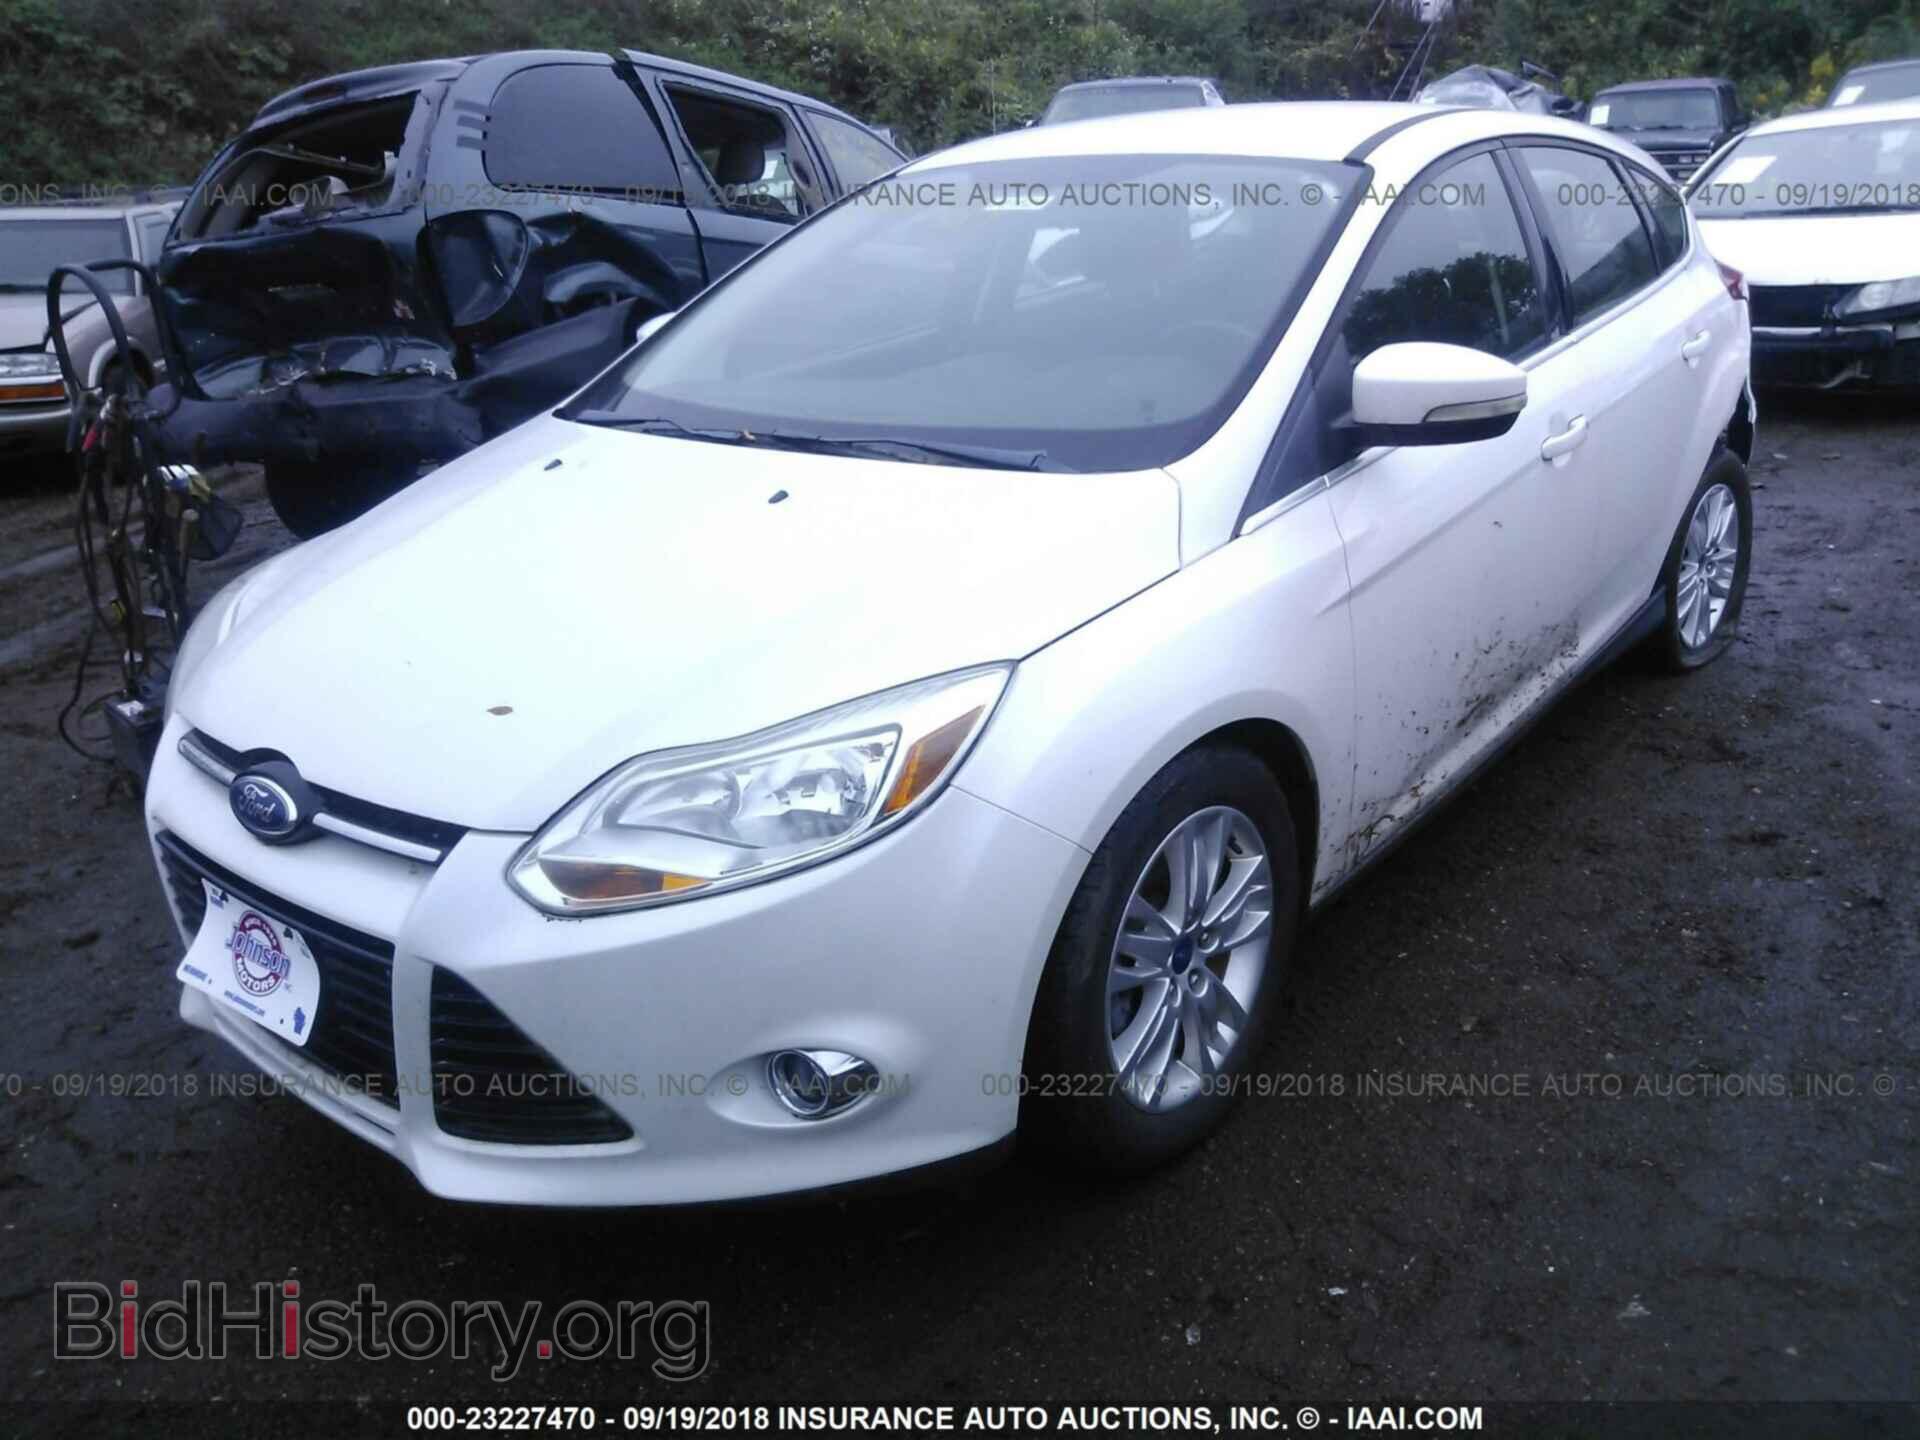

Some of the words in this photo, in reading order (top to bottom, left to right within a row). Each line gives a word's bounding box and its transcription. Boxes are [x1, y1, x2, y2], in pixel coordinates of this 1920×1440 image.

[238, 783, 277, 821] Ford
[226, 924, 291, 979] Johnson
[236, 957, 277, 992] MOTORS
